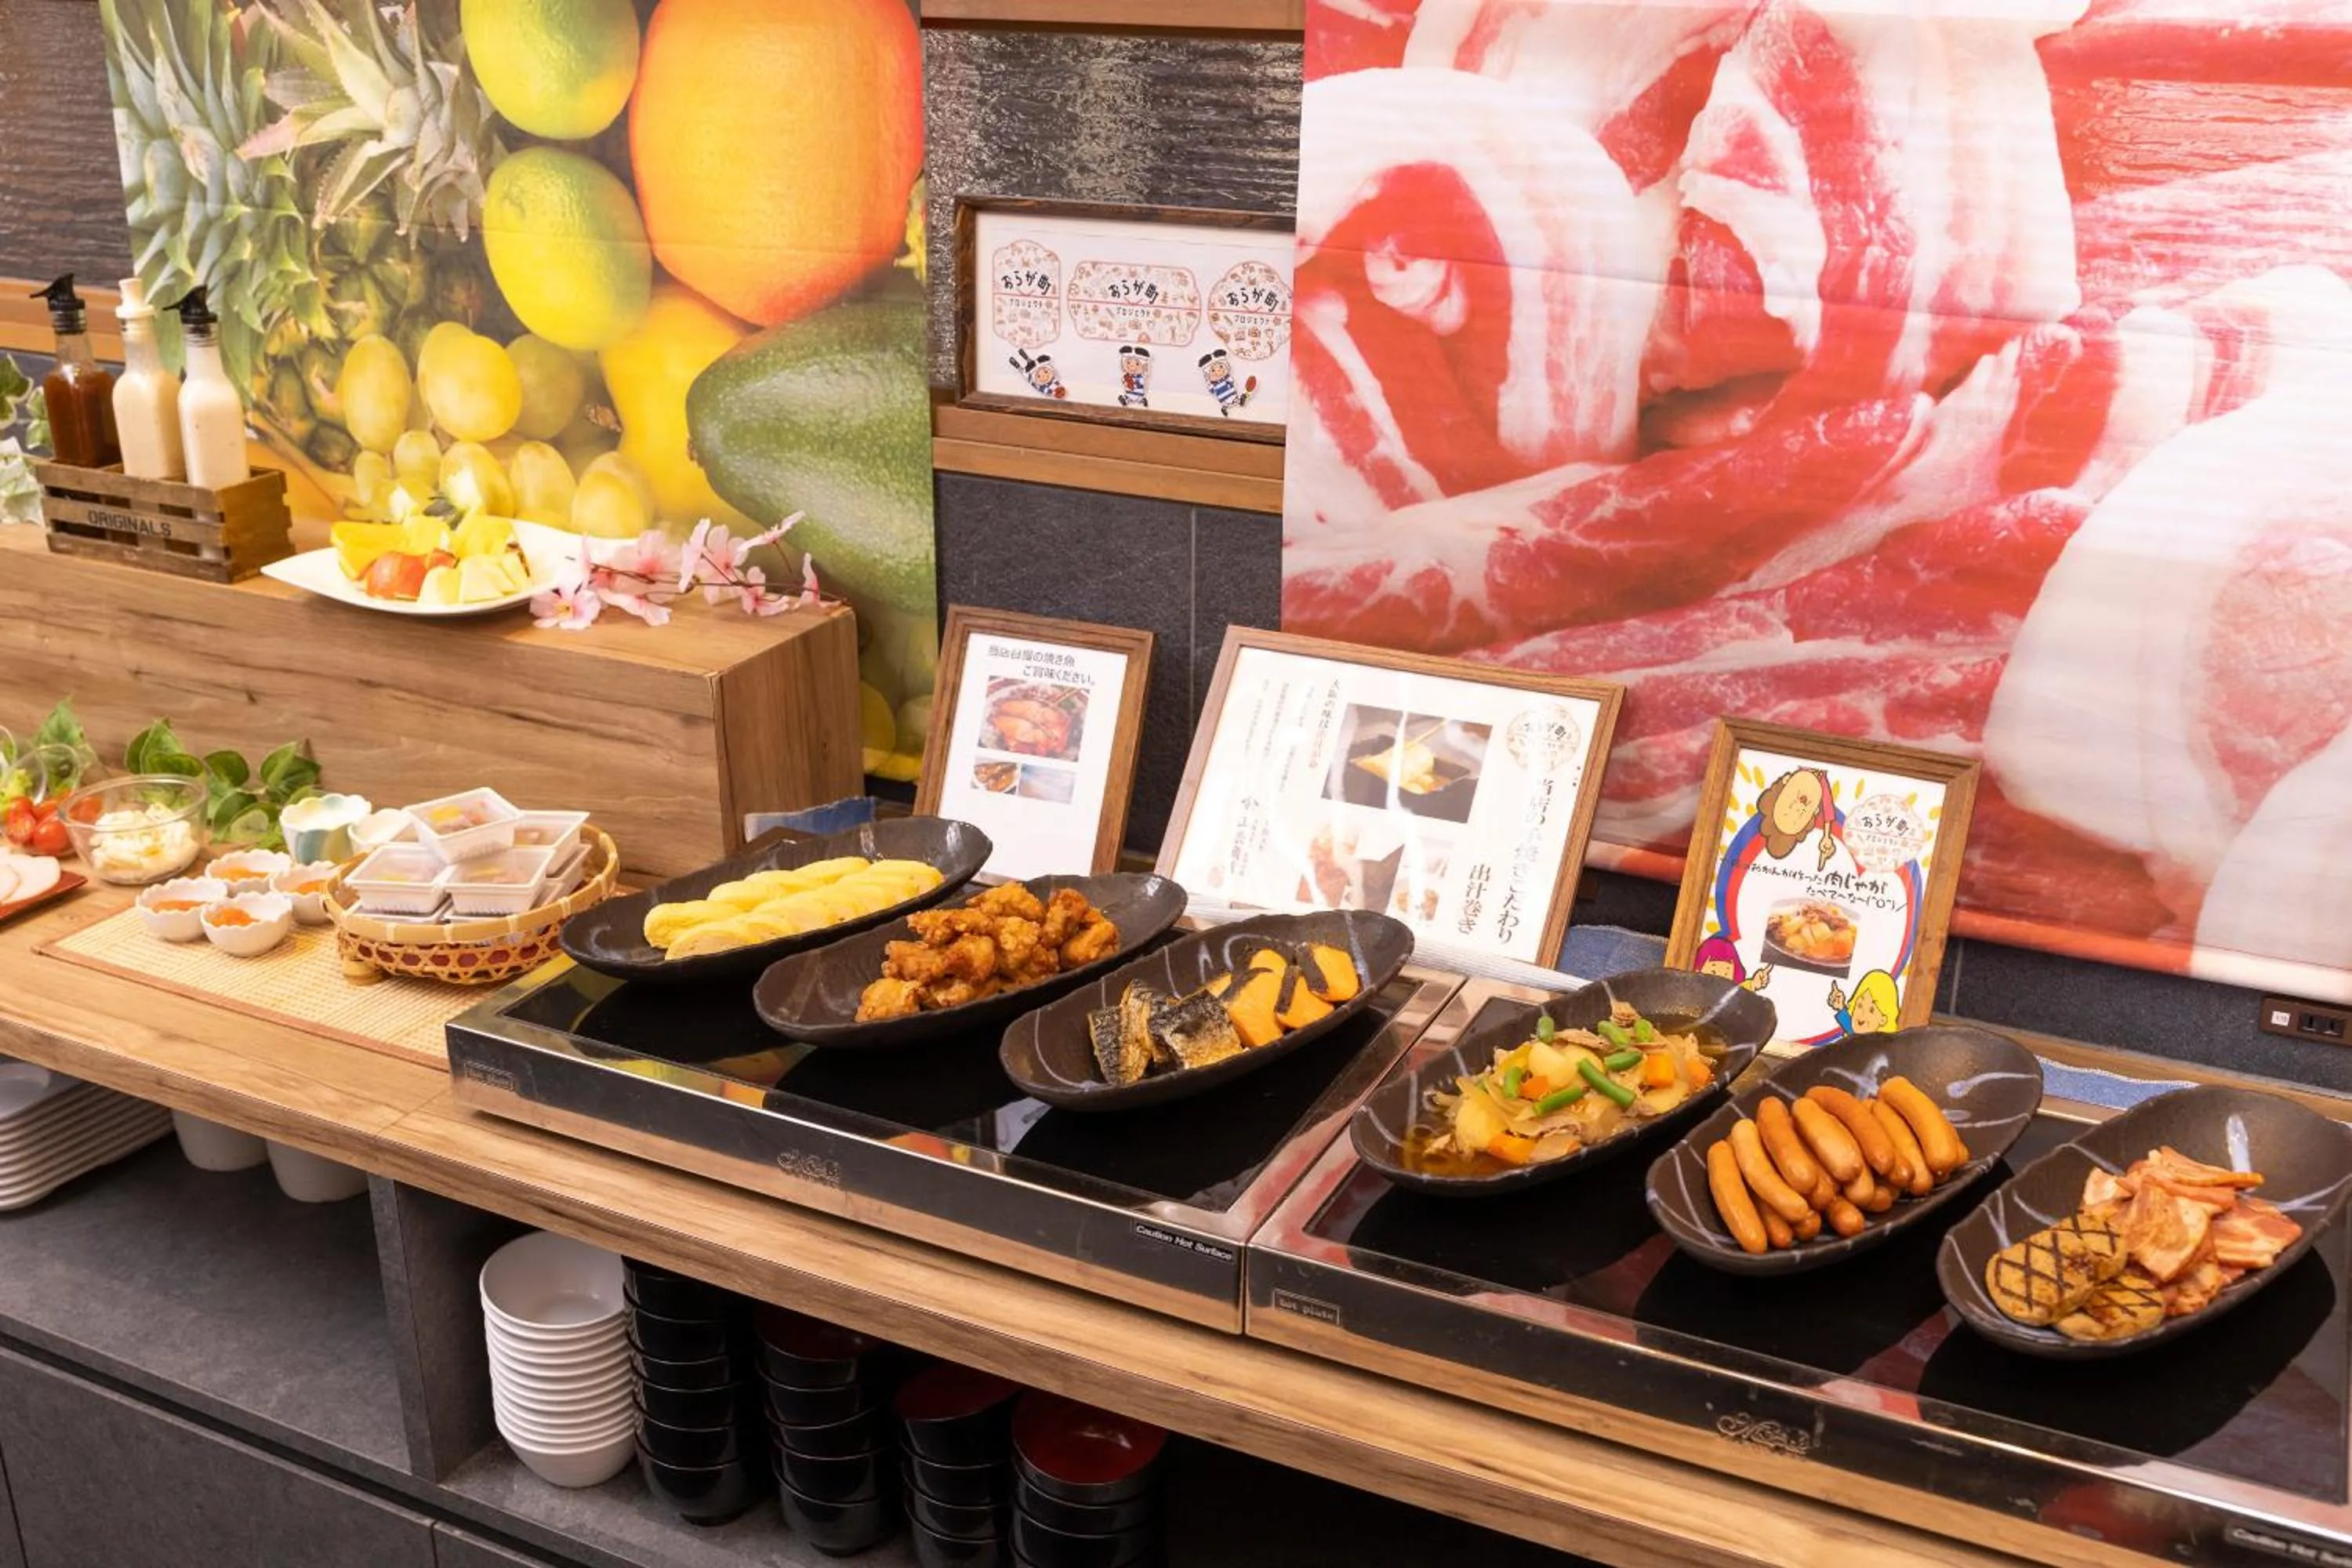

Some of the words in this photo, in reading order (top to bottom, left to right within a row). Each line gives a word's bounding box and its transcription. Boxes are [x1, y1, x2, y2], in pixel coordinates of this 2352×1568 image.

[1002, 270, 1051, 295] おらが町
[1109, 278, 1159, 303] おらが町
[1226, 287, 1279, 313] おらが町
[88, 510, 172, 537] ORIGINALS
[1136, 1225, 1173, 1242] Caution
[1174, 1237, 1193, 1249] Hot
[1195, 1243, 1232, 1260] Surface
